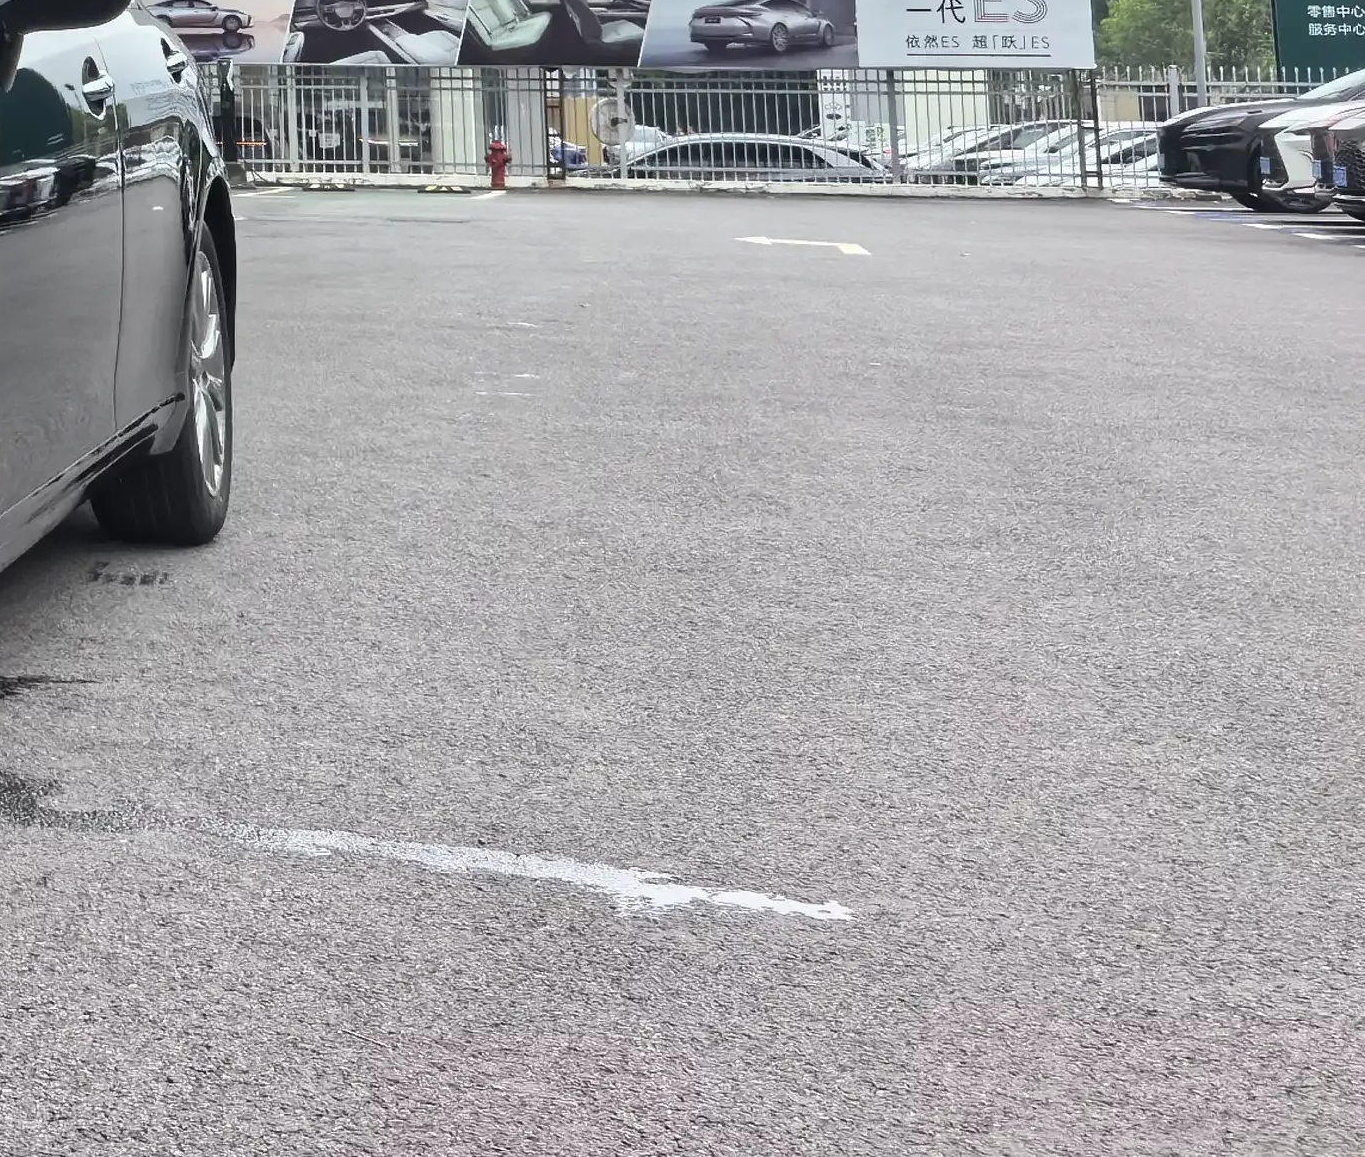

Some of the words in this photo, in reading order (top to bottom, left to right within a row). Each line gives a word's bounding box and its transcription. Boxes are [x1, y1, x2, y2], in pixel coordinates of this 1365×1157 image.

[1307, 4, 1365, 19] 零售中心
[1308, 22, 1365, 36] 服务中心
[905, 34, 960, 49] 依然ES
